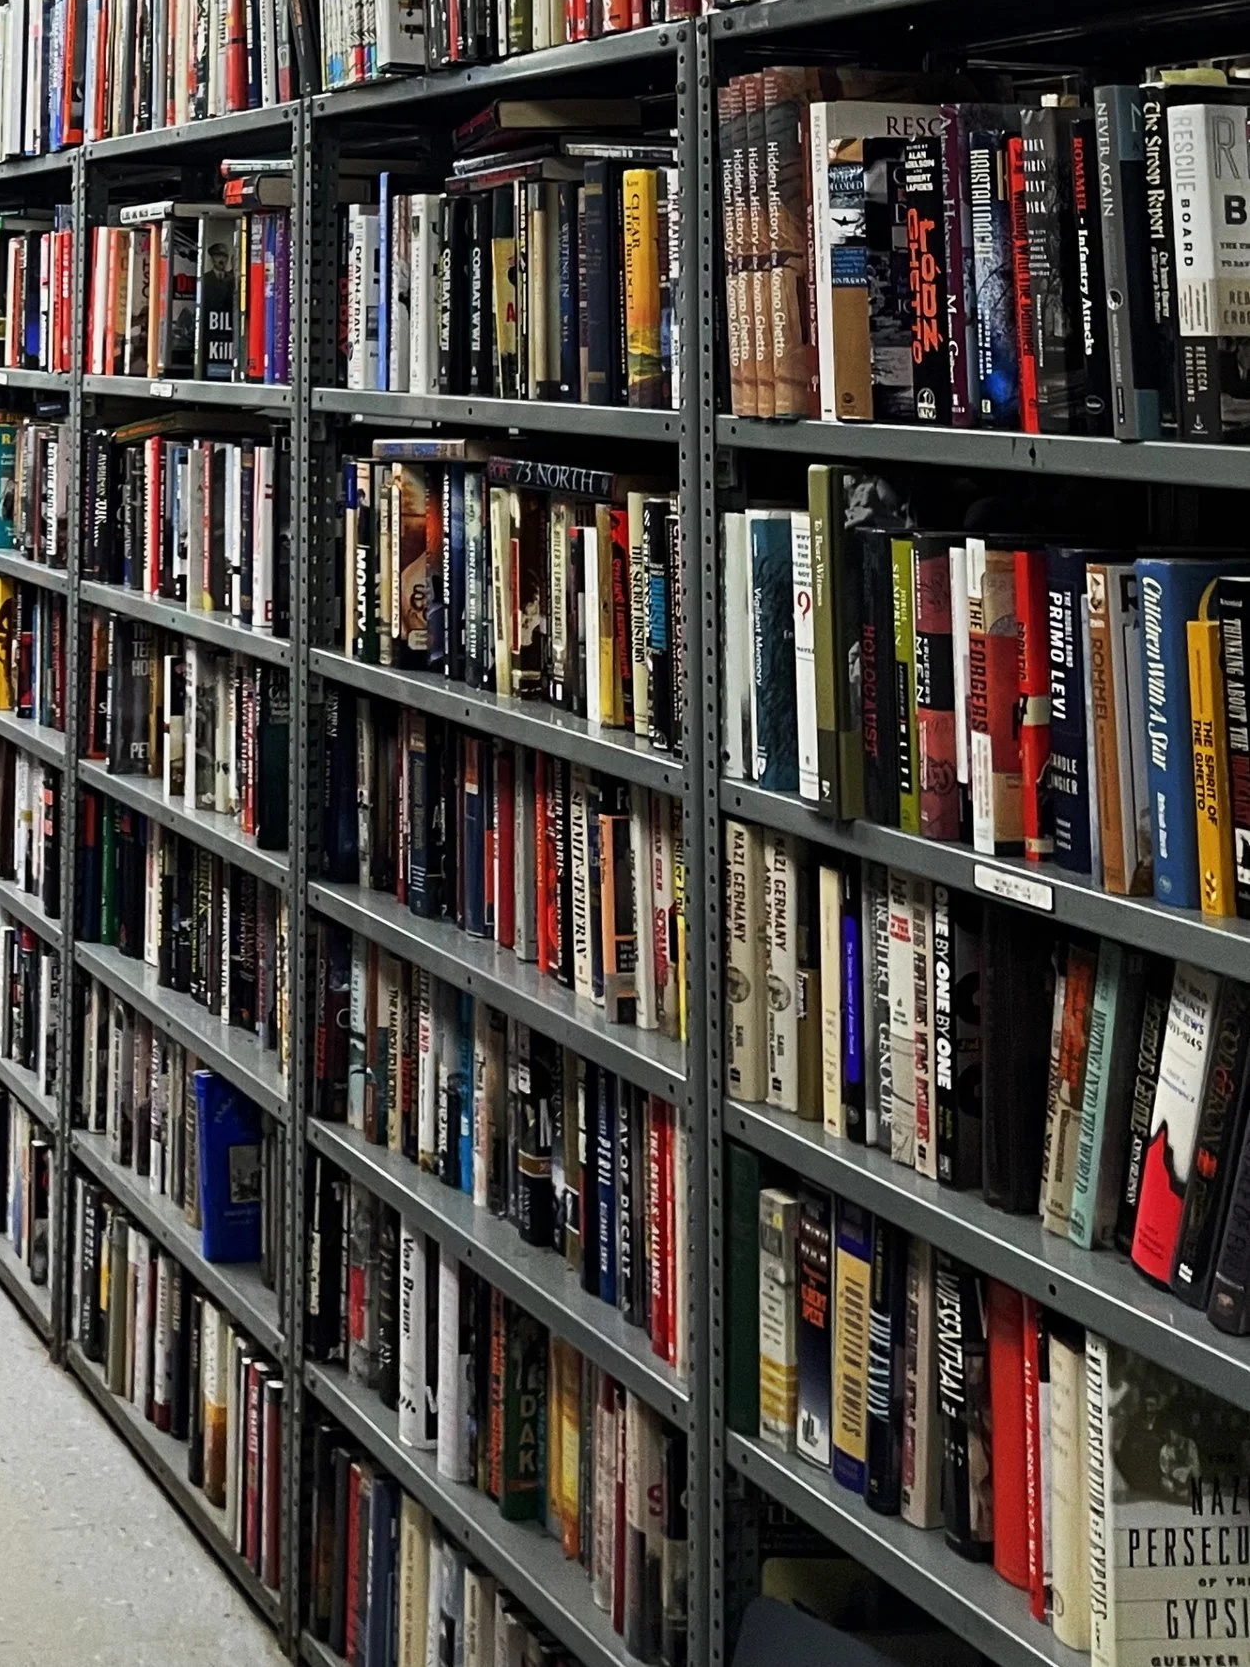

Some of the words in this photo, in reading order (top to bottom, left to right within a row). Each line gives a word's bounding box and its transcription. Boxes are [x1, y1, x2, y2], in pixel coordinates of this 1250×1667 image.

[1096, 102, 1110, 163] NEVER
[1143, 101, 1161, 133] The
[749, 147, 757, 194] Hidden
[768, 141, 778, 188] Hidden
[1073, 136, 1087, 210] ROMMEL
[1145, 135, 1163, 187] Stroop
[1172, 115, 1195, 193] RESCUE
[770, 191, 779, 240] History
[1100, 165, 1115, 217] AGAIN
[1148, 188, 1165, 239] Report
[631, 194, 641, 249] CLEAR
[750, 195, 759, 245] History
[1180, 198, 1194, 268] BOARD
[472, 247, 480, 308] COMBAT
[907, 208, 922, 365] GHETTO
[1078, 229, 1089, 295] Infantry
[753, 272, 763, 313] Kovno
[772, 267, 783, 309] Kovno
[756, 315, 764, 361] Ghetto
[773, 311, 786, 358] Ghetto
[1082, 299, 1093, 356] Attacks
[516, 460, 532, 483] 73
[537, 465, 595, 494] NORTH
[814, 519, 823, 532] To
[814, 535, 823, 561] Bear
[632, 545, 643, 568] THE
[357, 548, 367, 632] MONTY
[632, 570, 644, 612] SECRET
[815, 563, 824, 607] Witness
[753, 587, 763, 638] Vigilant
[970, 600, 983, 630] THE
[1049, 590, 1066, 663] PRIMO
[1142, 576, 1163, 661] Children
[633, 614, 646, 665] HISTORY
[755, 639, 765, 687] Memory
[1221, 617, 1245, 677] THINKING
[862, 622, 879, 759] HOLOCAUST
[915, 635, 925, 704] MEN
[970, 637, 988, 732] FORGERS
[1090, 637, 1110, 722] ROMMEL
[1147, 660, 1166, 706] With
[1050, 671, 1066, 720] LEVI
[1226, 682, 1247, 725] ABOUT
[1150, 725, 1168, 772] Star
[1193, 719, 1202, 748] THE
[1202, 720, 1213, 748] THE
[1230, 726, 1249, 753] THE
[1195, 751, 1206, 812] GHETTO
[1204, 753, 1217, 800] SPIRIT
[1207, 805, 1218, 828] OF
[555, 819, 565, 877] HARRIS
[733, 829, 745, 871] NAZI
[774, 837, 786, 875] NAZI
[733, 871, 746, 944] GERMANY
[774, 876, 787, 952] GERMANY
[934, 885, 949, 937] ONE
[936, 938, 949, 958] BY
[936, 959, 951, 1015] ONE
[937, 1016, 950, 1037] BY
[879, 1022, 892, 1127] GENOCIDE
[937, 1041, 952, 1091] ONE
[619, 1106, 628, 1148] DAY
[620, 1155, 629, 1185] OF
[403, 1237, 414, 1270] Von
[621, 1194, 630, 1279] DECEIT
[936, 1269, 965, 1403] WIESENTHAL
[1198, 1577, 1217, 1588] OF
[1151, 1655, 1239, 1667] GUENTER
